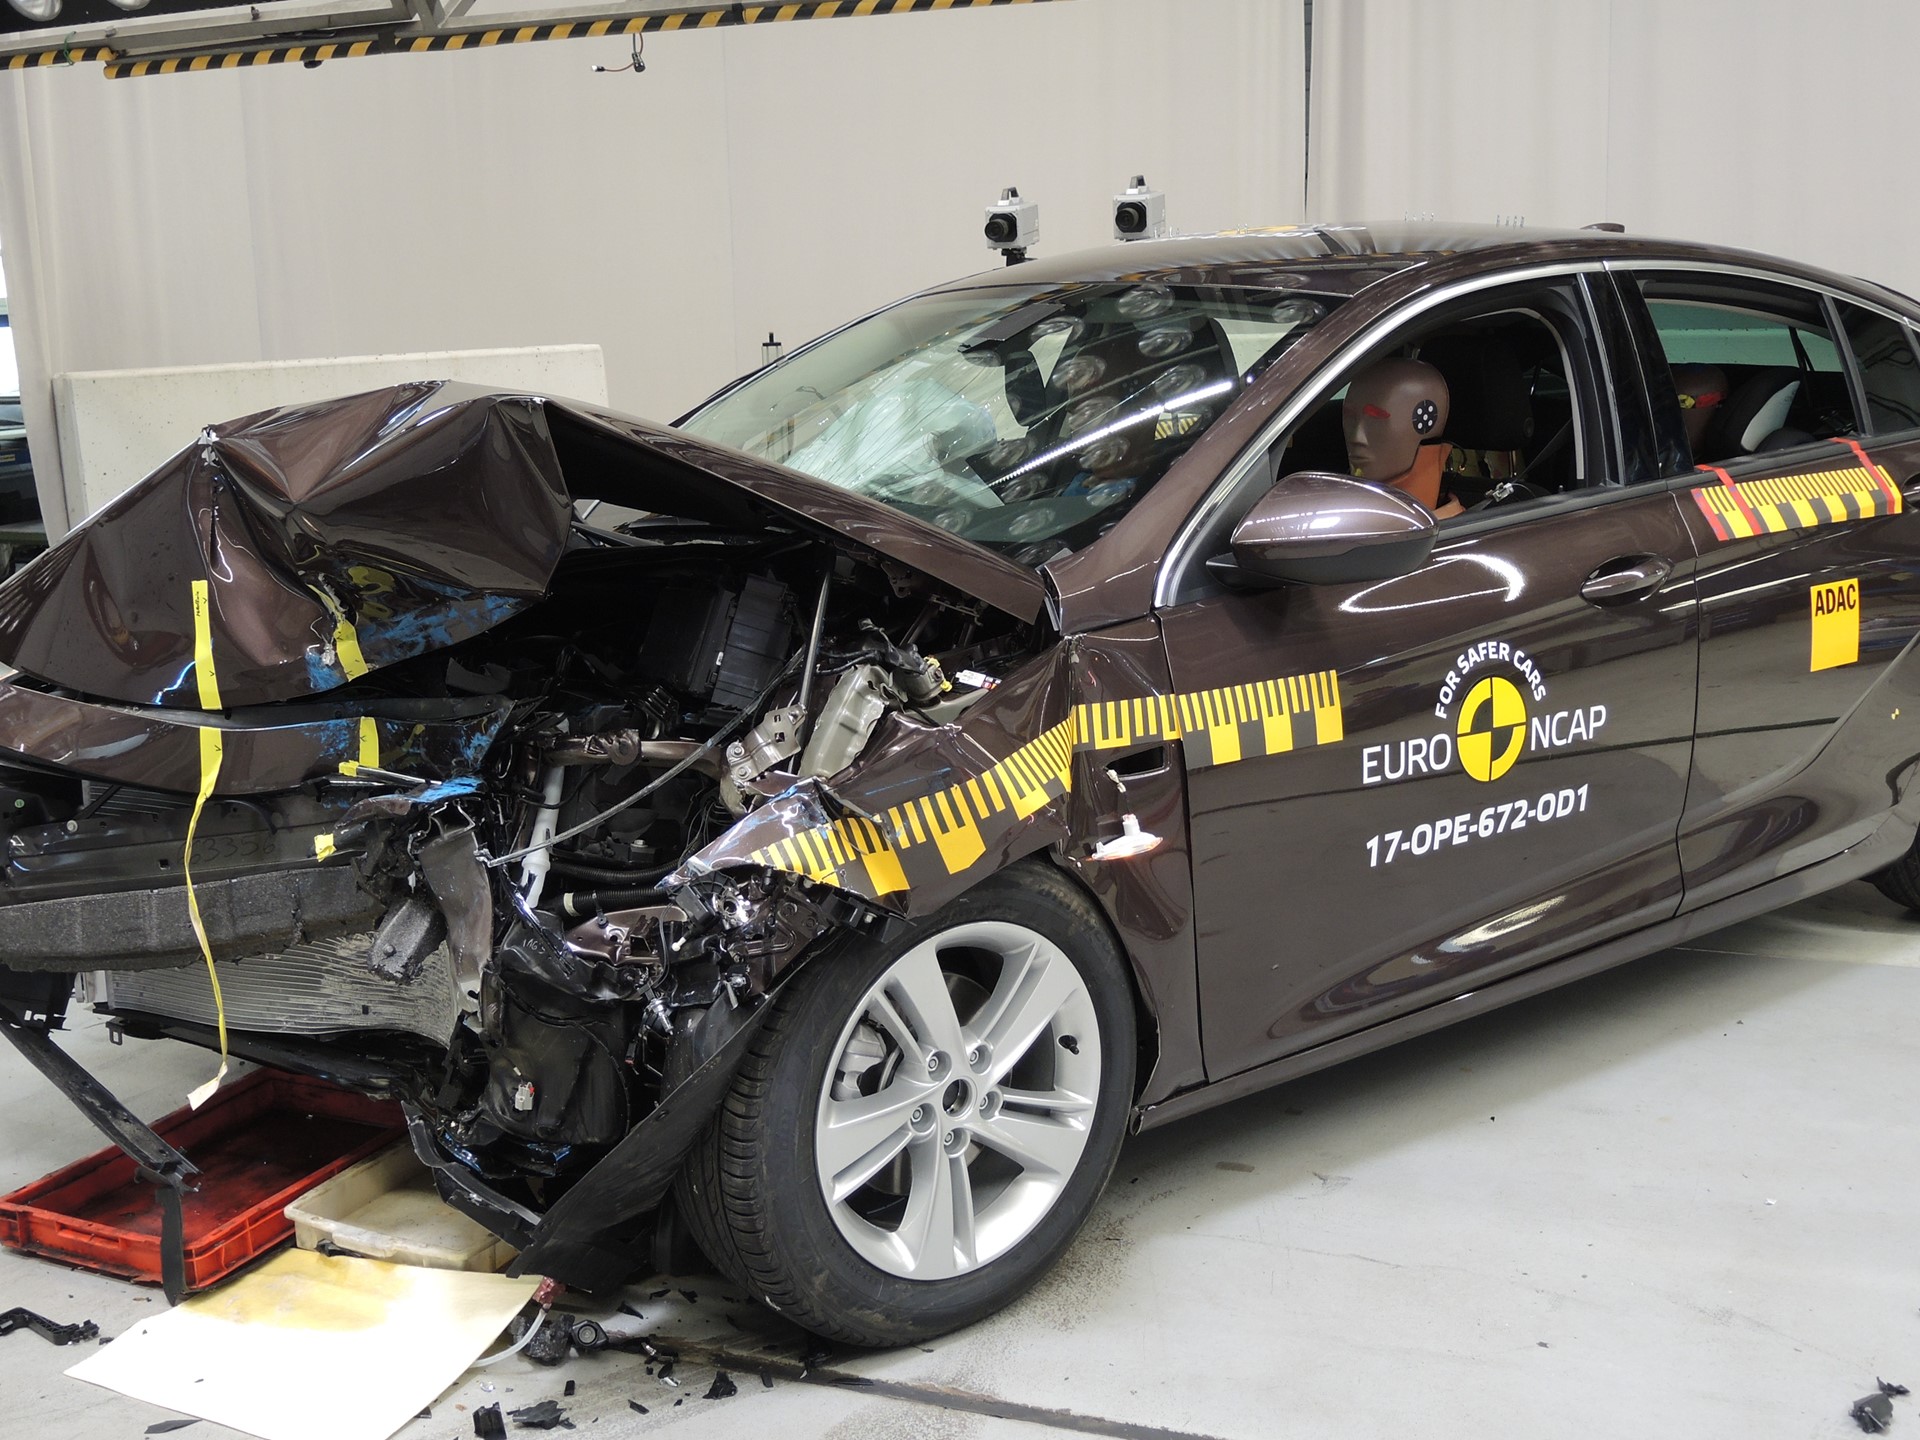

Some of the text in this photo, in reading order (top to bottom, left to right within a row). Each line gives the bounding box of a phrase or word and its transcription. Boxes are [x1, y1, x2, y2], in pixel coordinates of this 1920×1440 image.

[1815, 584, 1856, 616] ADAC
[1435, 641, 1546, 719] FOR SAFER CARS
[1362, 705, 1607, 784] EURO NCAP
